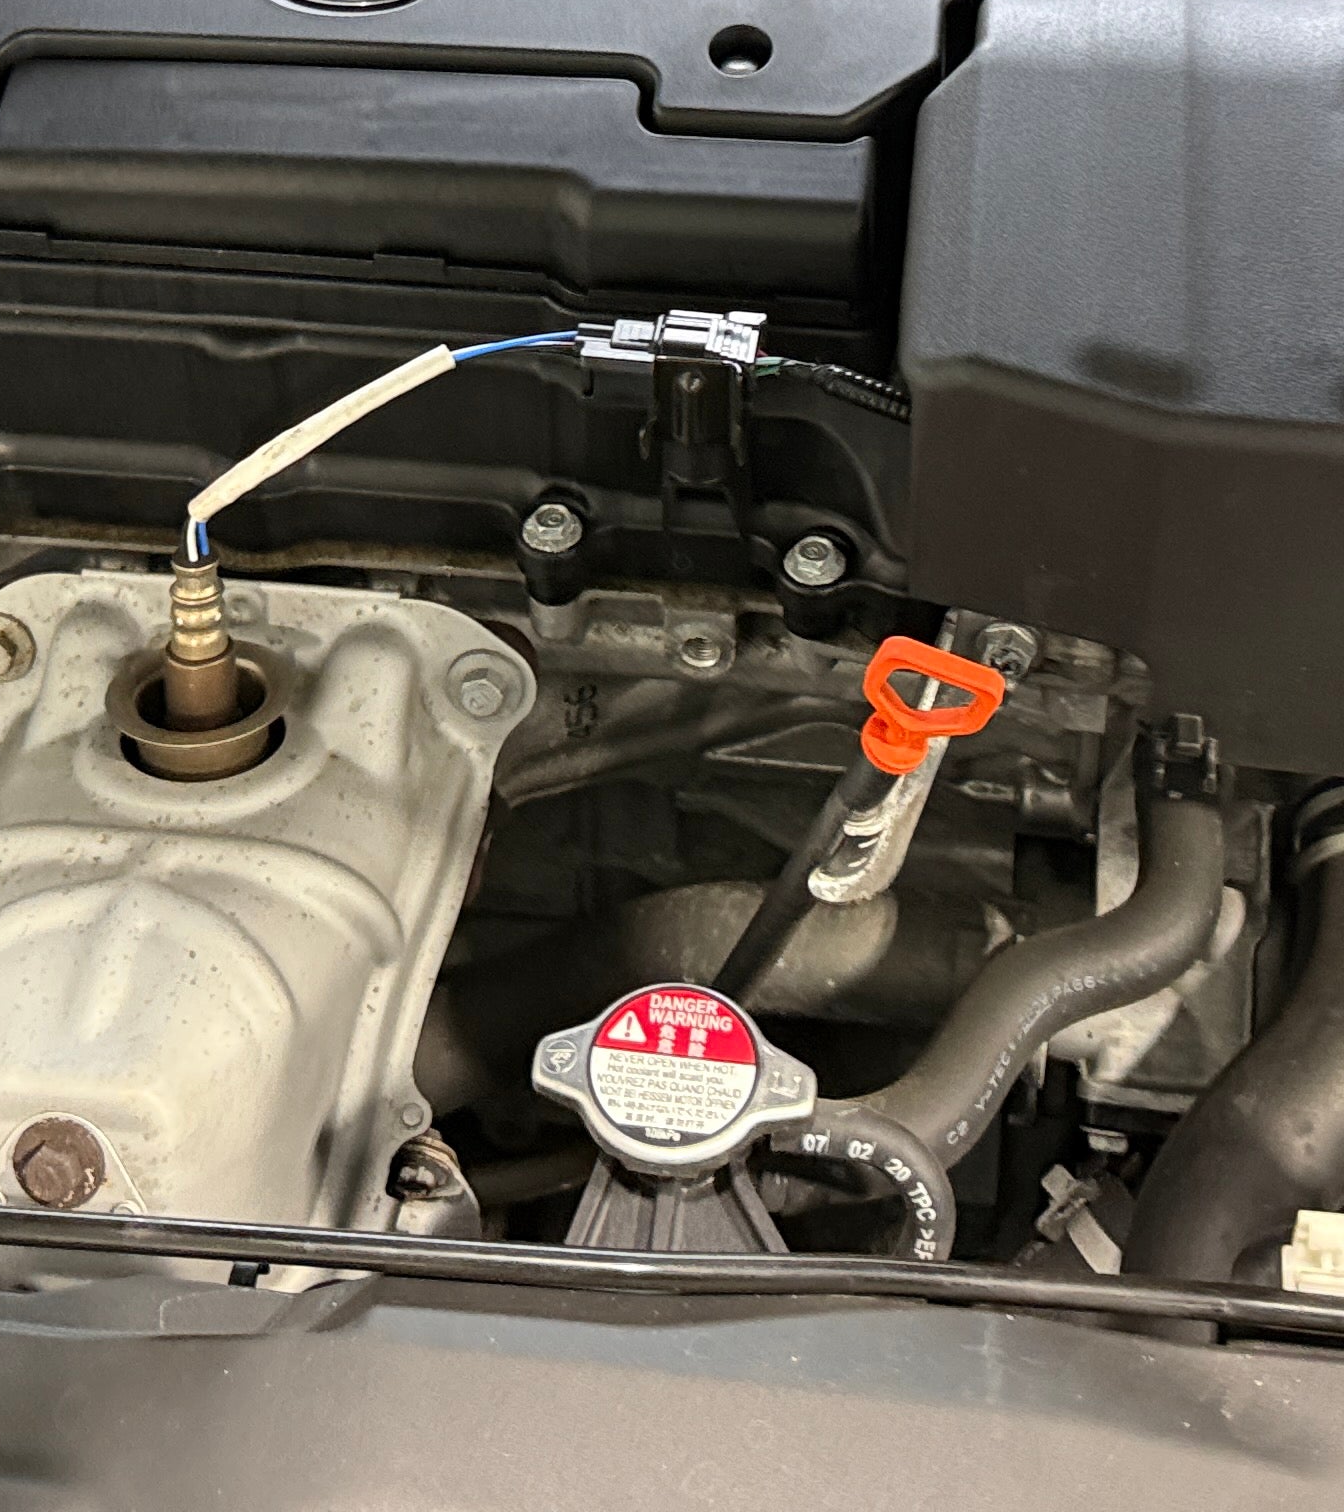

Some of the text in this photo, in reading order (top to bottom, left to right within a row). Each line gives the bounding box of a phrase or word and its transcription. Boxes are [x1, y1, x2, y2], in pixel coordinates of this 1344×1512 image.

[649, 993, 719, 1016] DANGER
[648, 1009, 733, 1032] WARNUNG
[609, 1053, 645, 1065] NEVER
[647, 1057, 676, 1069] OPEN
[679, 1059, 710, 1072] WHEN
[847, 1139, 875, 1161] 02
[883, 1158, 912, 1182] 20
[907, 1181, 937, 1222] TPC
